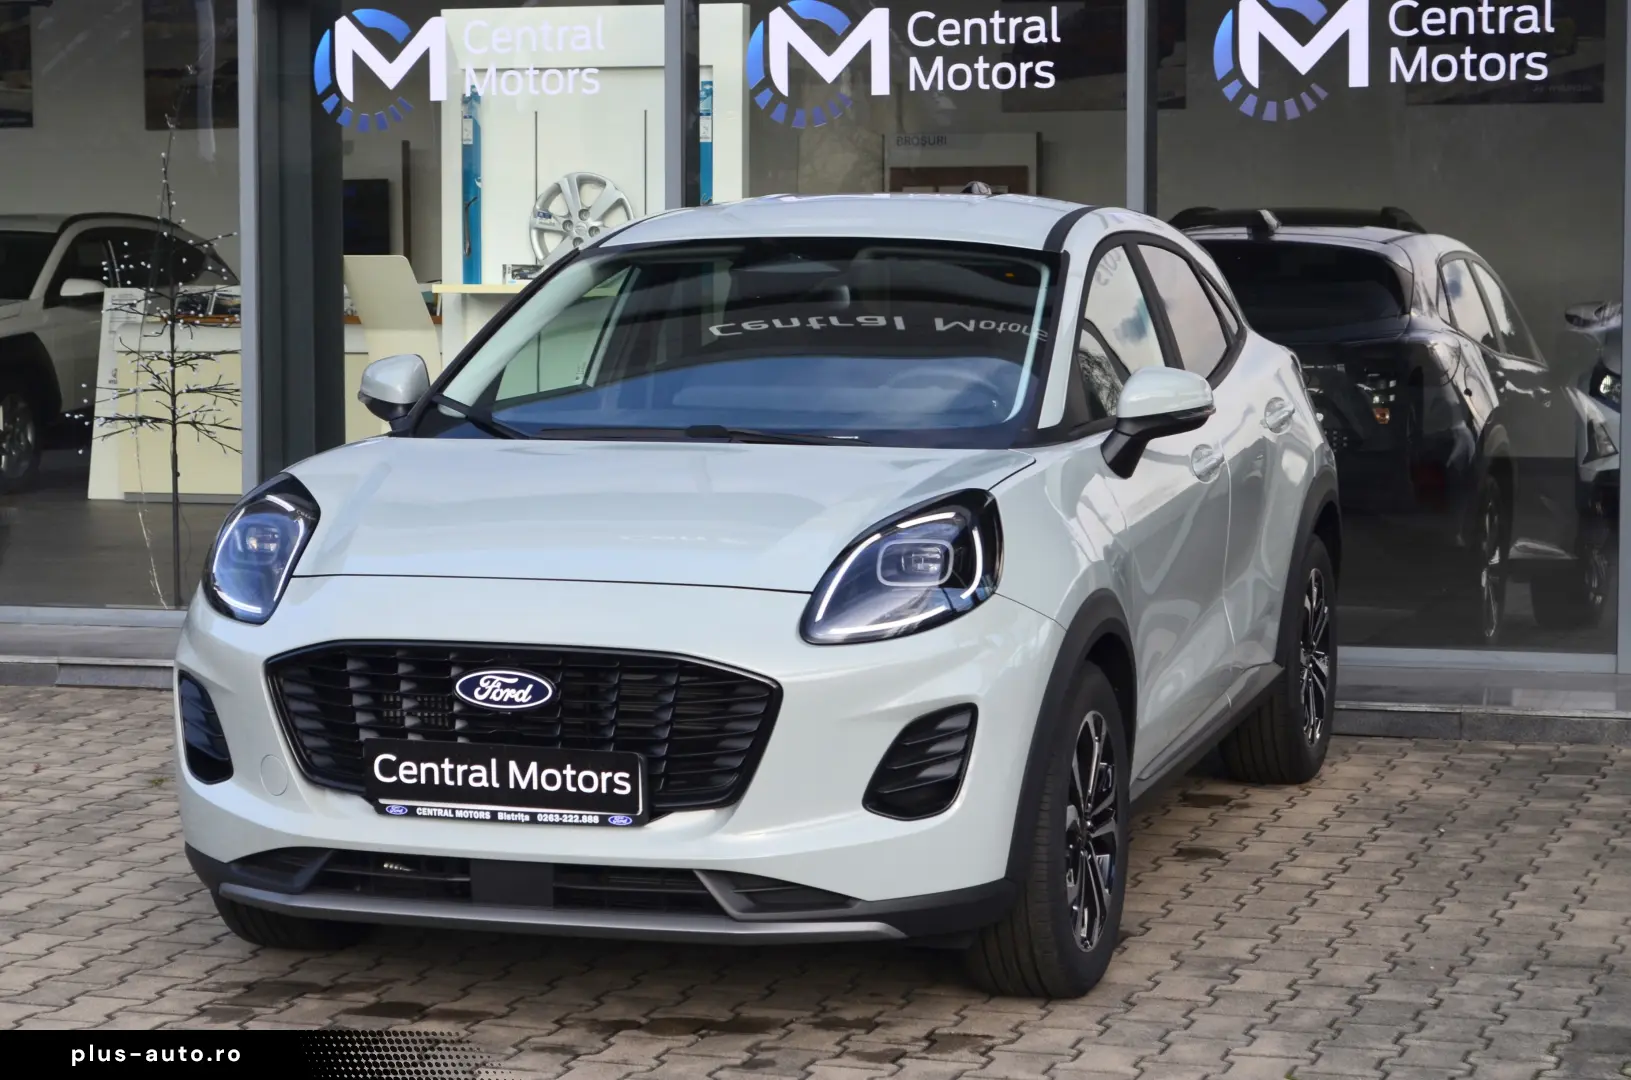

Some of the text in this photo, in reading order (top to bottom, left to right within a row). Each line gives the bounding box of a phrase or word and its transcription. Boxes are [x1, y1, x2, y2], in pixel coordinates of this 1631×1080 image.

[462, 16, 605, 55] Central
[907, 6, 1061, 47] Central
[1388, 0, 1555, 37] Central
[464, 64, 601, 98] Motors
[909, 56, 1056, 91] Motors
[1389, 46, 1549, 84] Motors
[473, 675, 533, 703] Ford
[373, 754, 632, 795] Central Motors
[387, 805, 406, 814] Ford
[416, 807, 454, 818] CENTRAL
[455, 810, 491, 820] MOTORS
[610, 816, 630, 825] Ford
